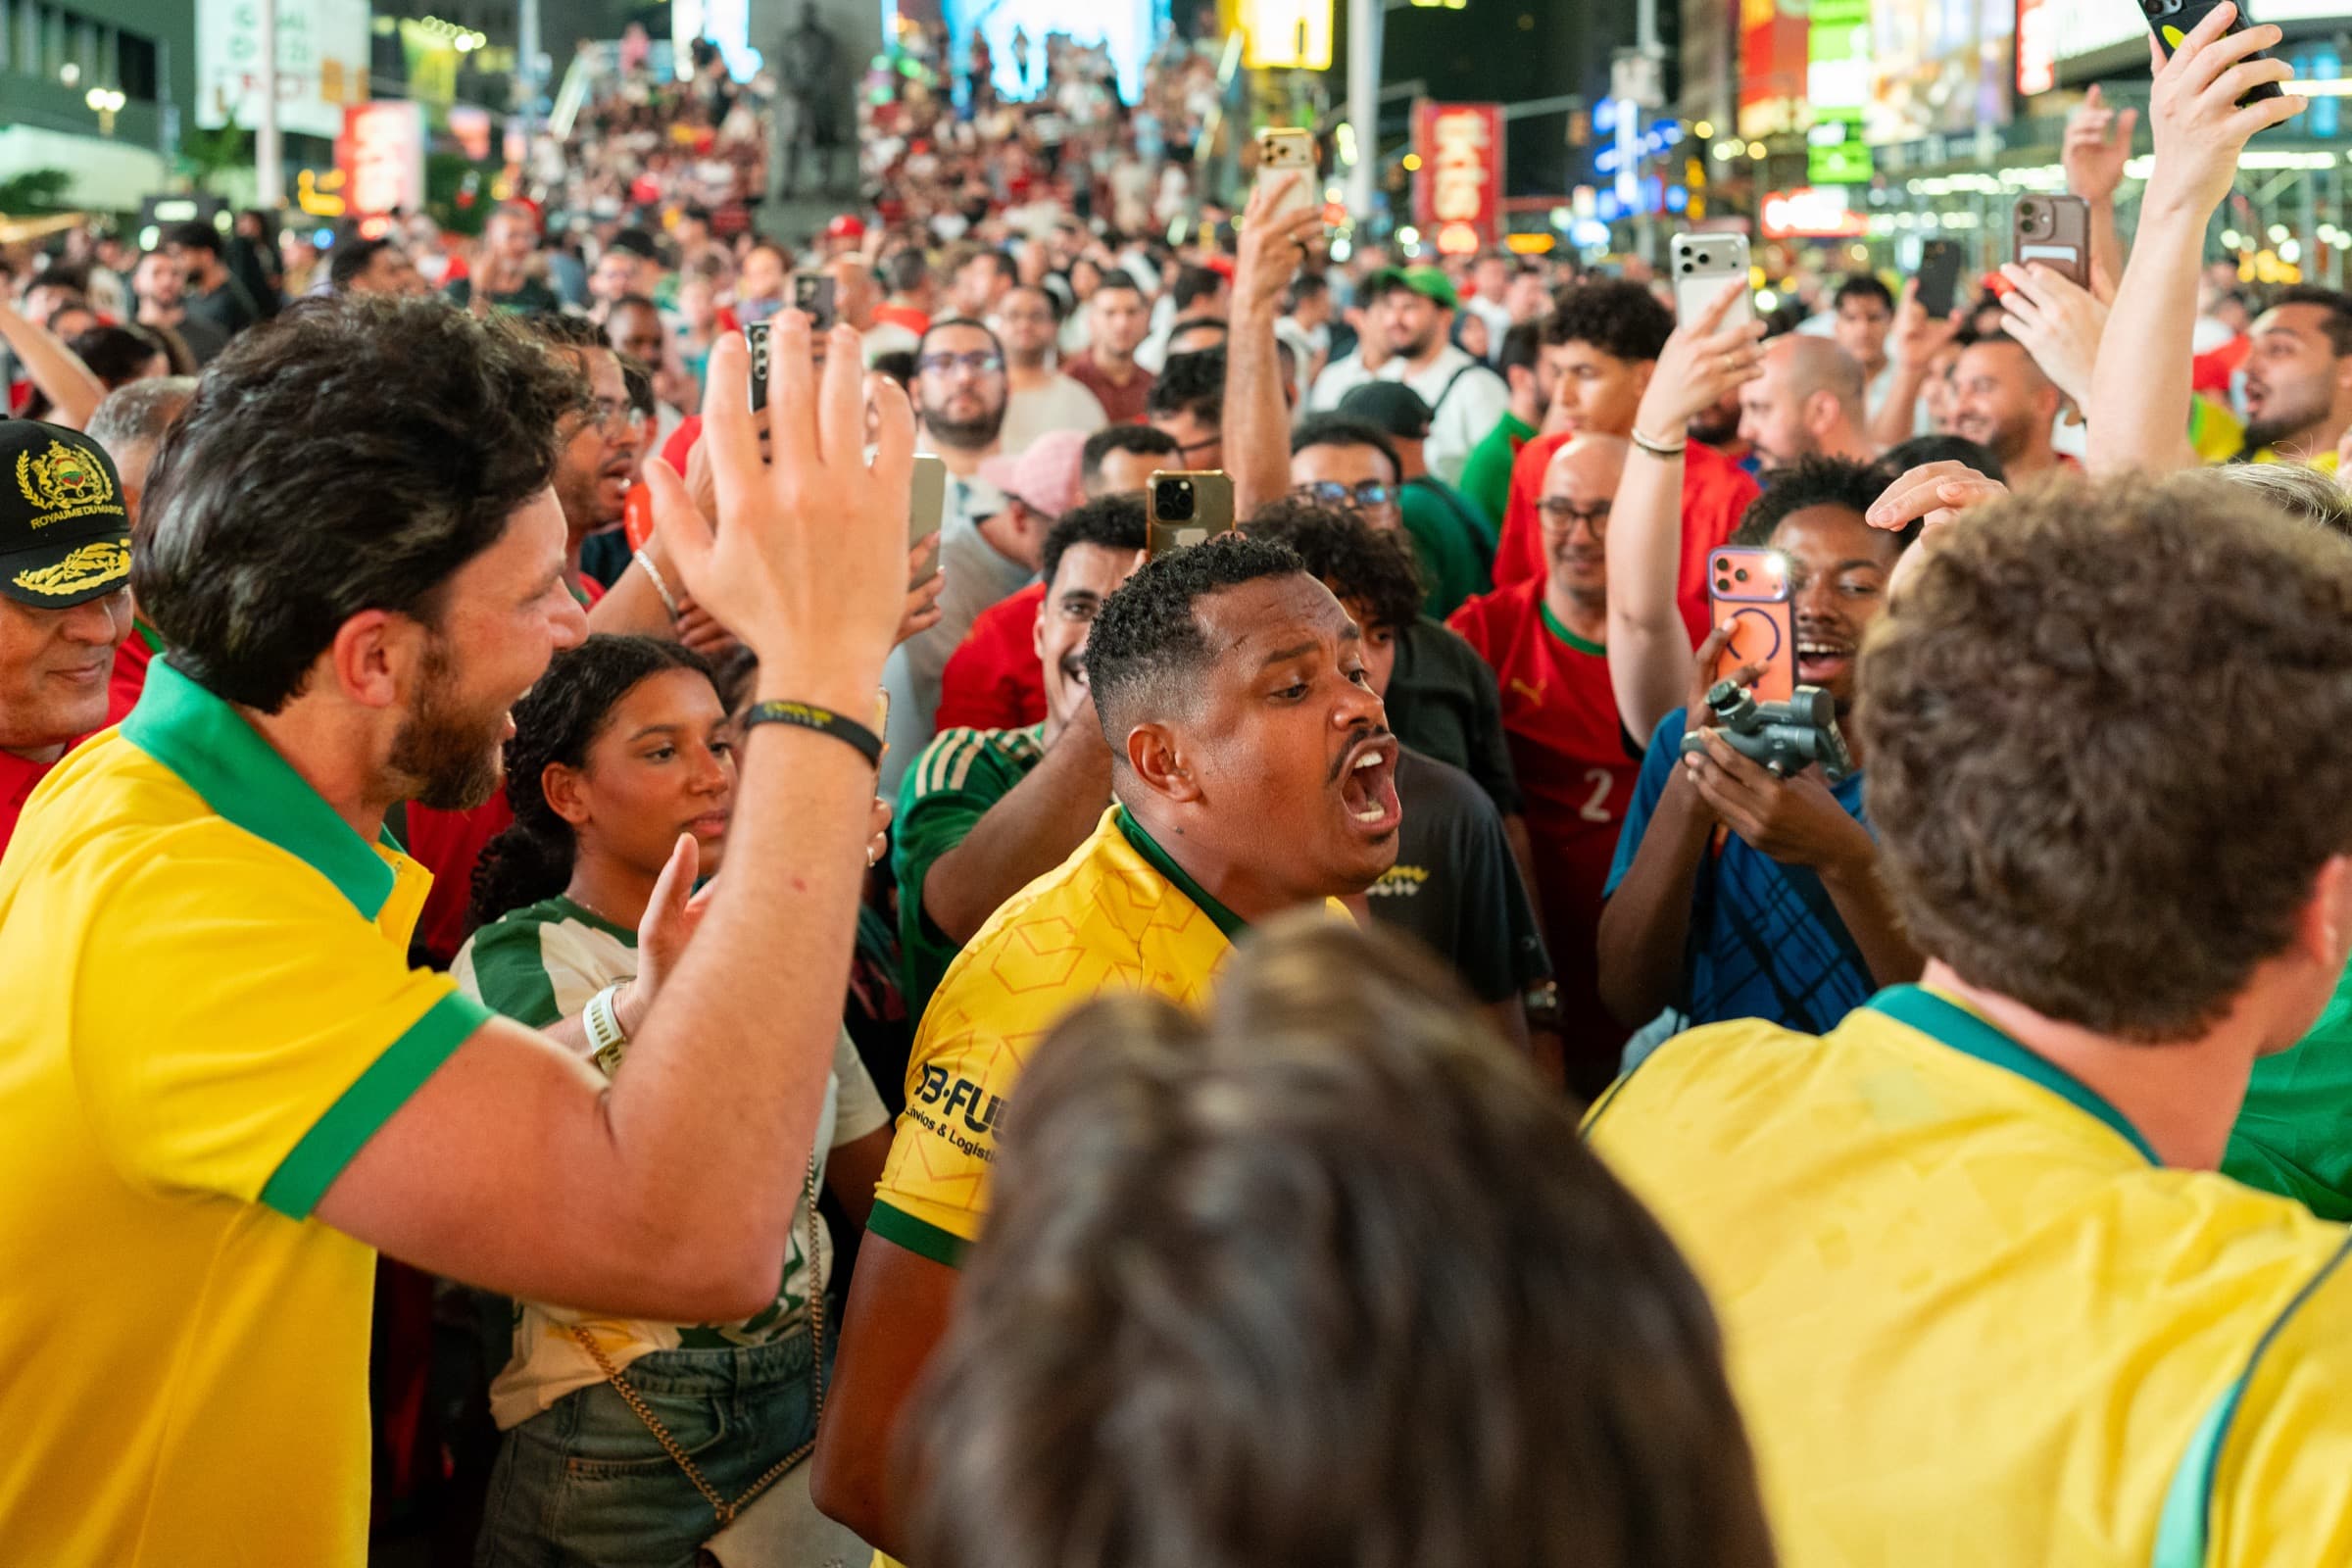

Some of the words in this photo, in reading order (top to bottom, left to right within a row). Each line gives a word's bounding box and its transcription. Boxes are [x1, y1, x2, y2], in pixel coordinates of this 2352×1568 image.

[30, 508, 83, 529] ROYAUME
[83, 506, 97, 515] DU
[1581, 768, 1613, 821] 2
[937, 1124, 948, 1138] &
